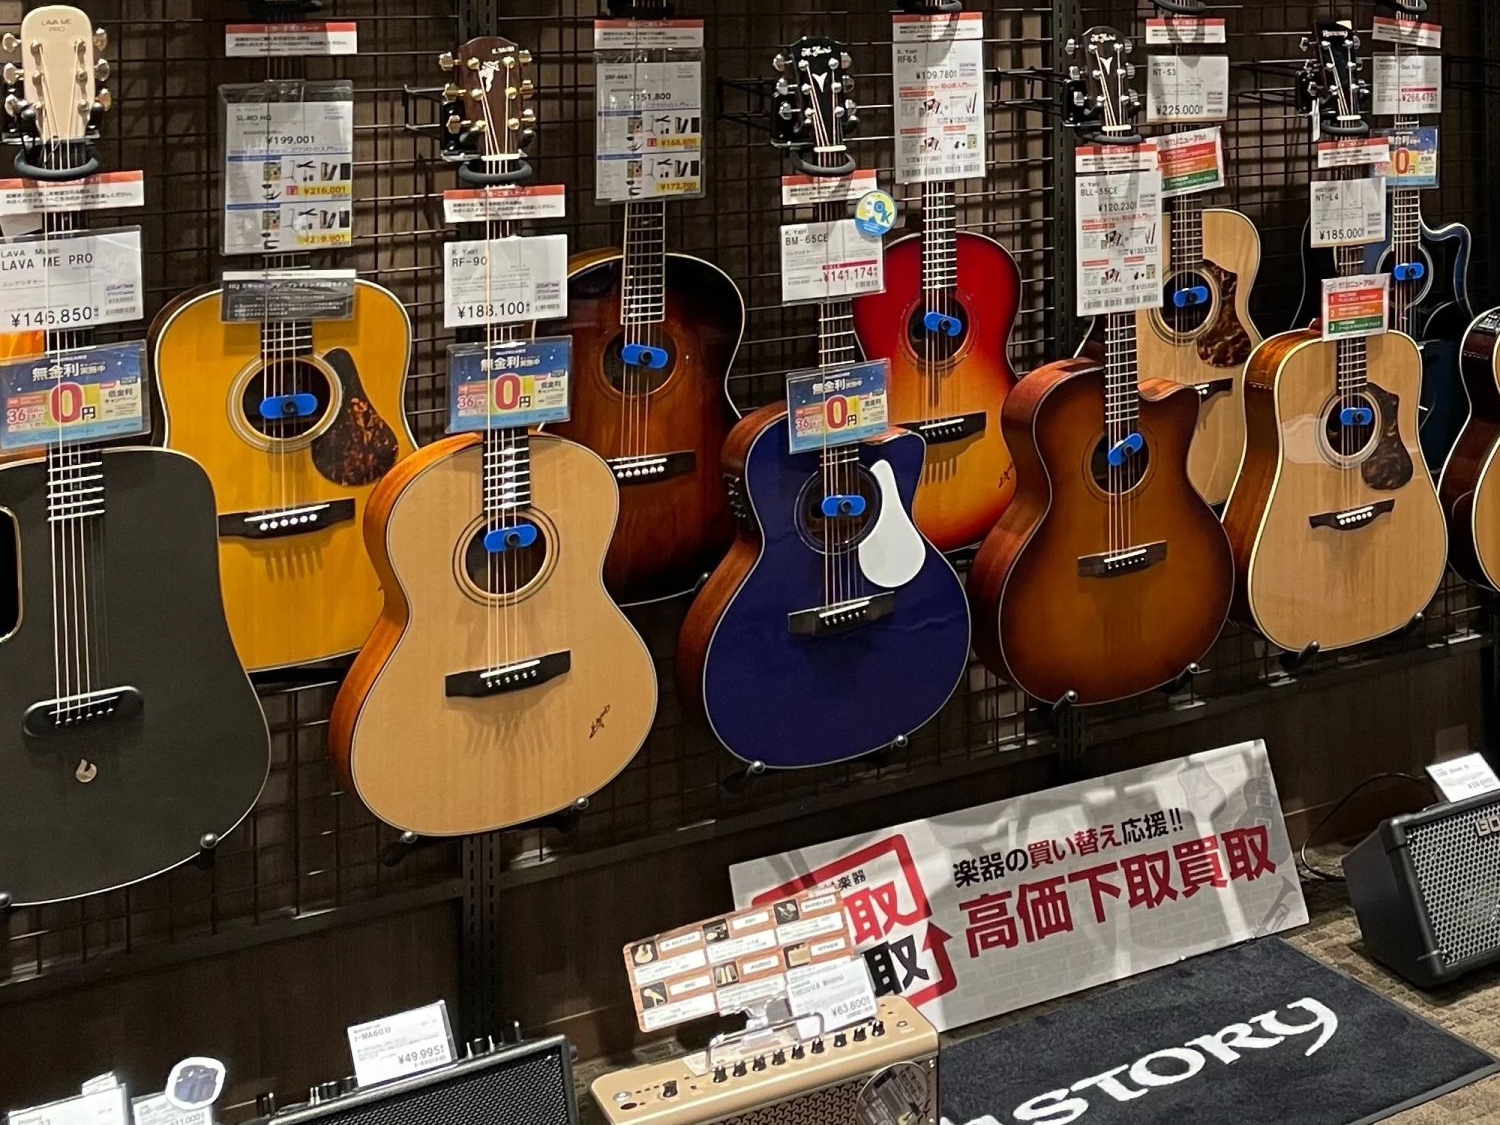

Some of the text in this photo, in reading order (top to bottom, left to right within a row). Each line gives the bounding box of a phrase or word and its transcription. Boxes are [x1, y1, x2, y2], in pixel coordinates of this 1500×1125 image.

[785, 234, 829, 247] BM-65CE
[1, 249, 26, 258] LAVA
[1, 253, 94, 271] LAVA ME PRO
[452, 256, 487, 268] RF-90
[32, 362, 79, 383] 無金利
[959, 825, 1278, 959] 高価下取買取
